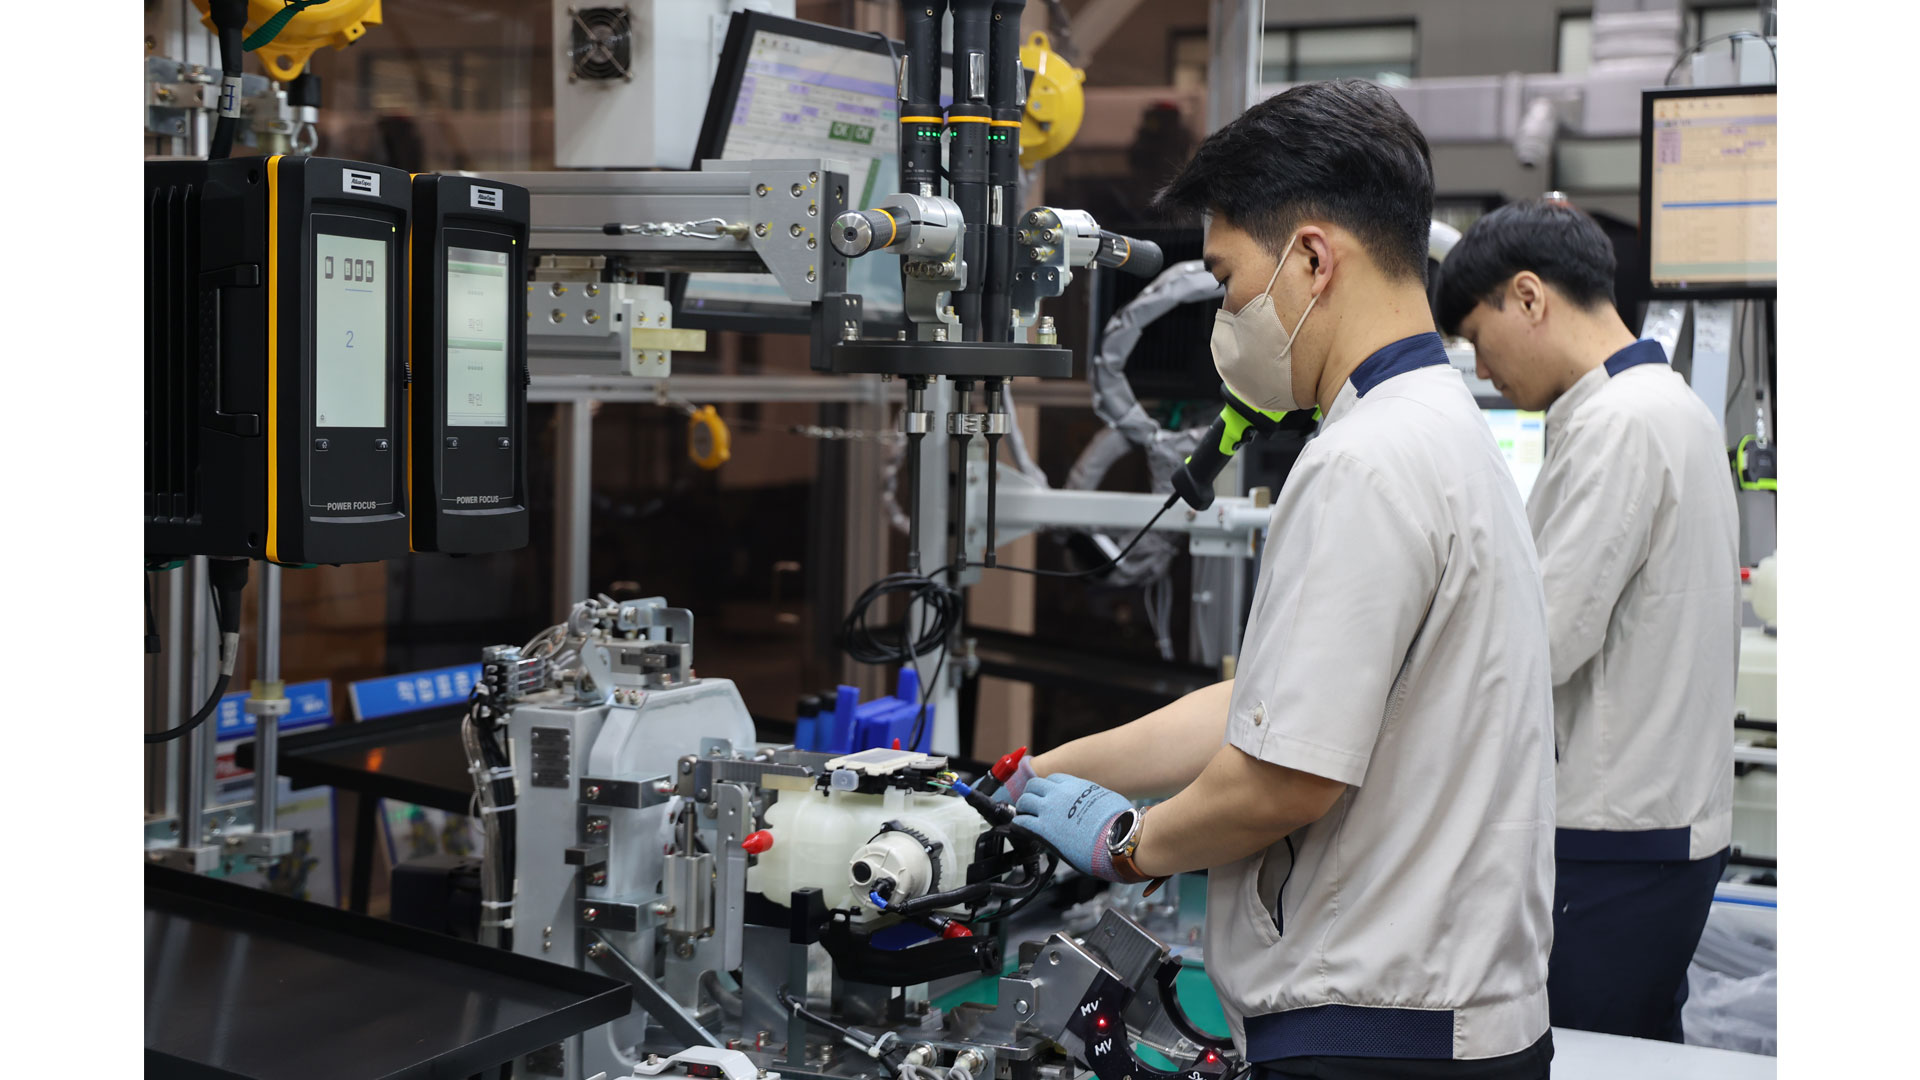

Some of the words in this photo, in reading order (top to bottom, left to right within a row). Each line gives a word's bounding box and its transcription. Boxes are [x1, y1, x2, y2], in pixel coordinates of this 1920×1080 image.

[345, 330, 354, 348] 2
[327, 502, 352, 511] POWER
[353, 501, 376, 510] FOCUS
[456, 496, 478, 504] POWER
[479, 495, 499, 503] FOCUS
[1080, 1000, 1099, 1017] MV
[1094, 1038, 1112, 1056] MV
